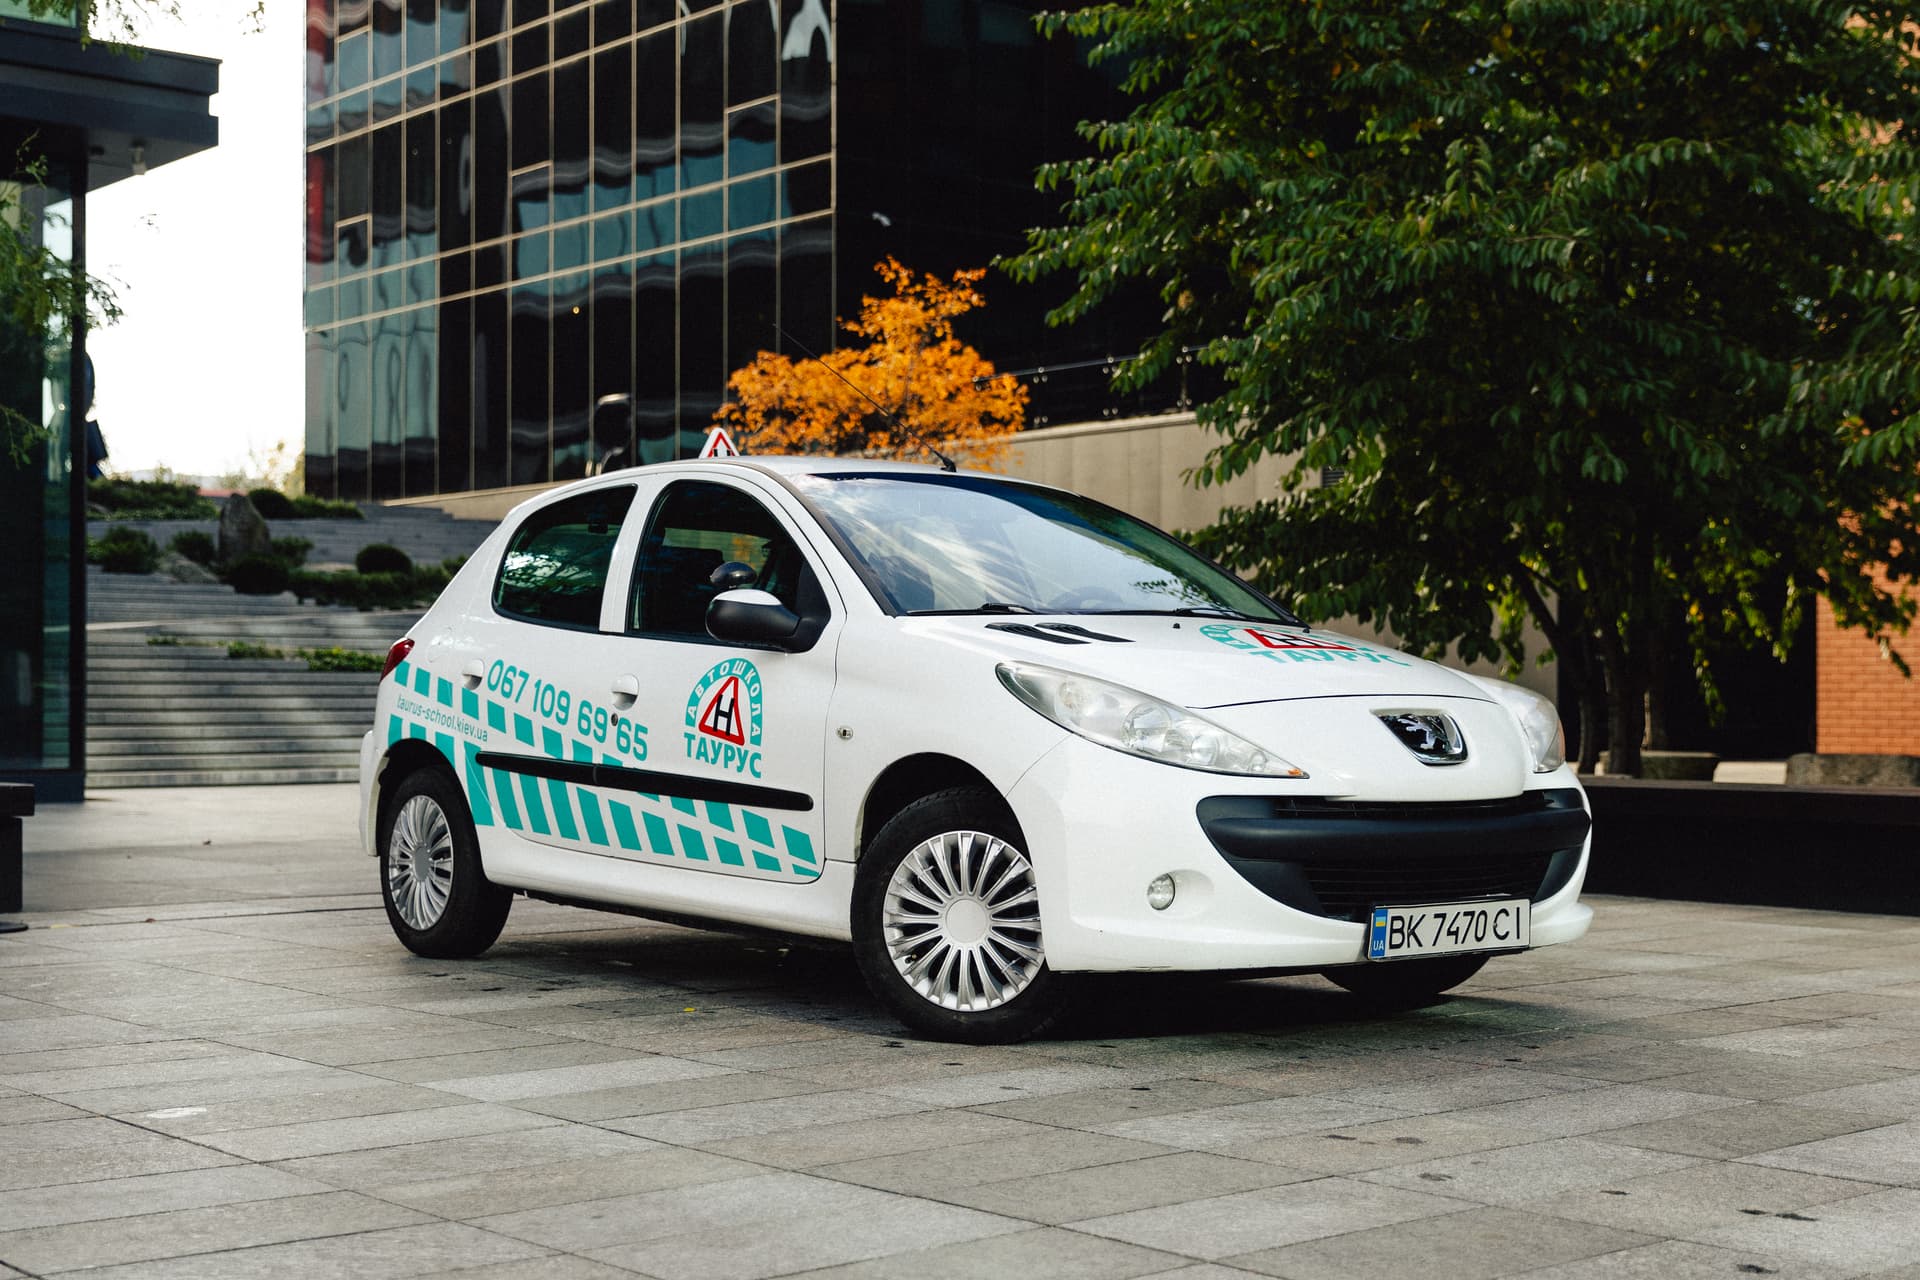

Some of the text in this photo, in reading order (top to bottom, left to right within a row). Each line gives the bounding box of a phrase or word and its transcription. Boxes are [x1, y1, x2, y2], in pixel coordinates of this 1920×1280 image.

[1249, 649, 1412, 667] ТАУРУС
[397, 694, 488, 742] taurus-school.kiev.ua
[487, 659, 649, 761] 067 109 69 65
[687, 659, 761, 737] АВТОШКОЛА
[684, 731, 762, 779] ТАУРУС
[1373, 939, 1385, 951] UA
[1389, 907, 1520, 949] BK 7470 CI
